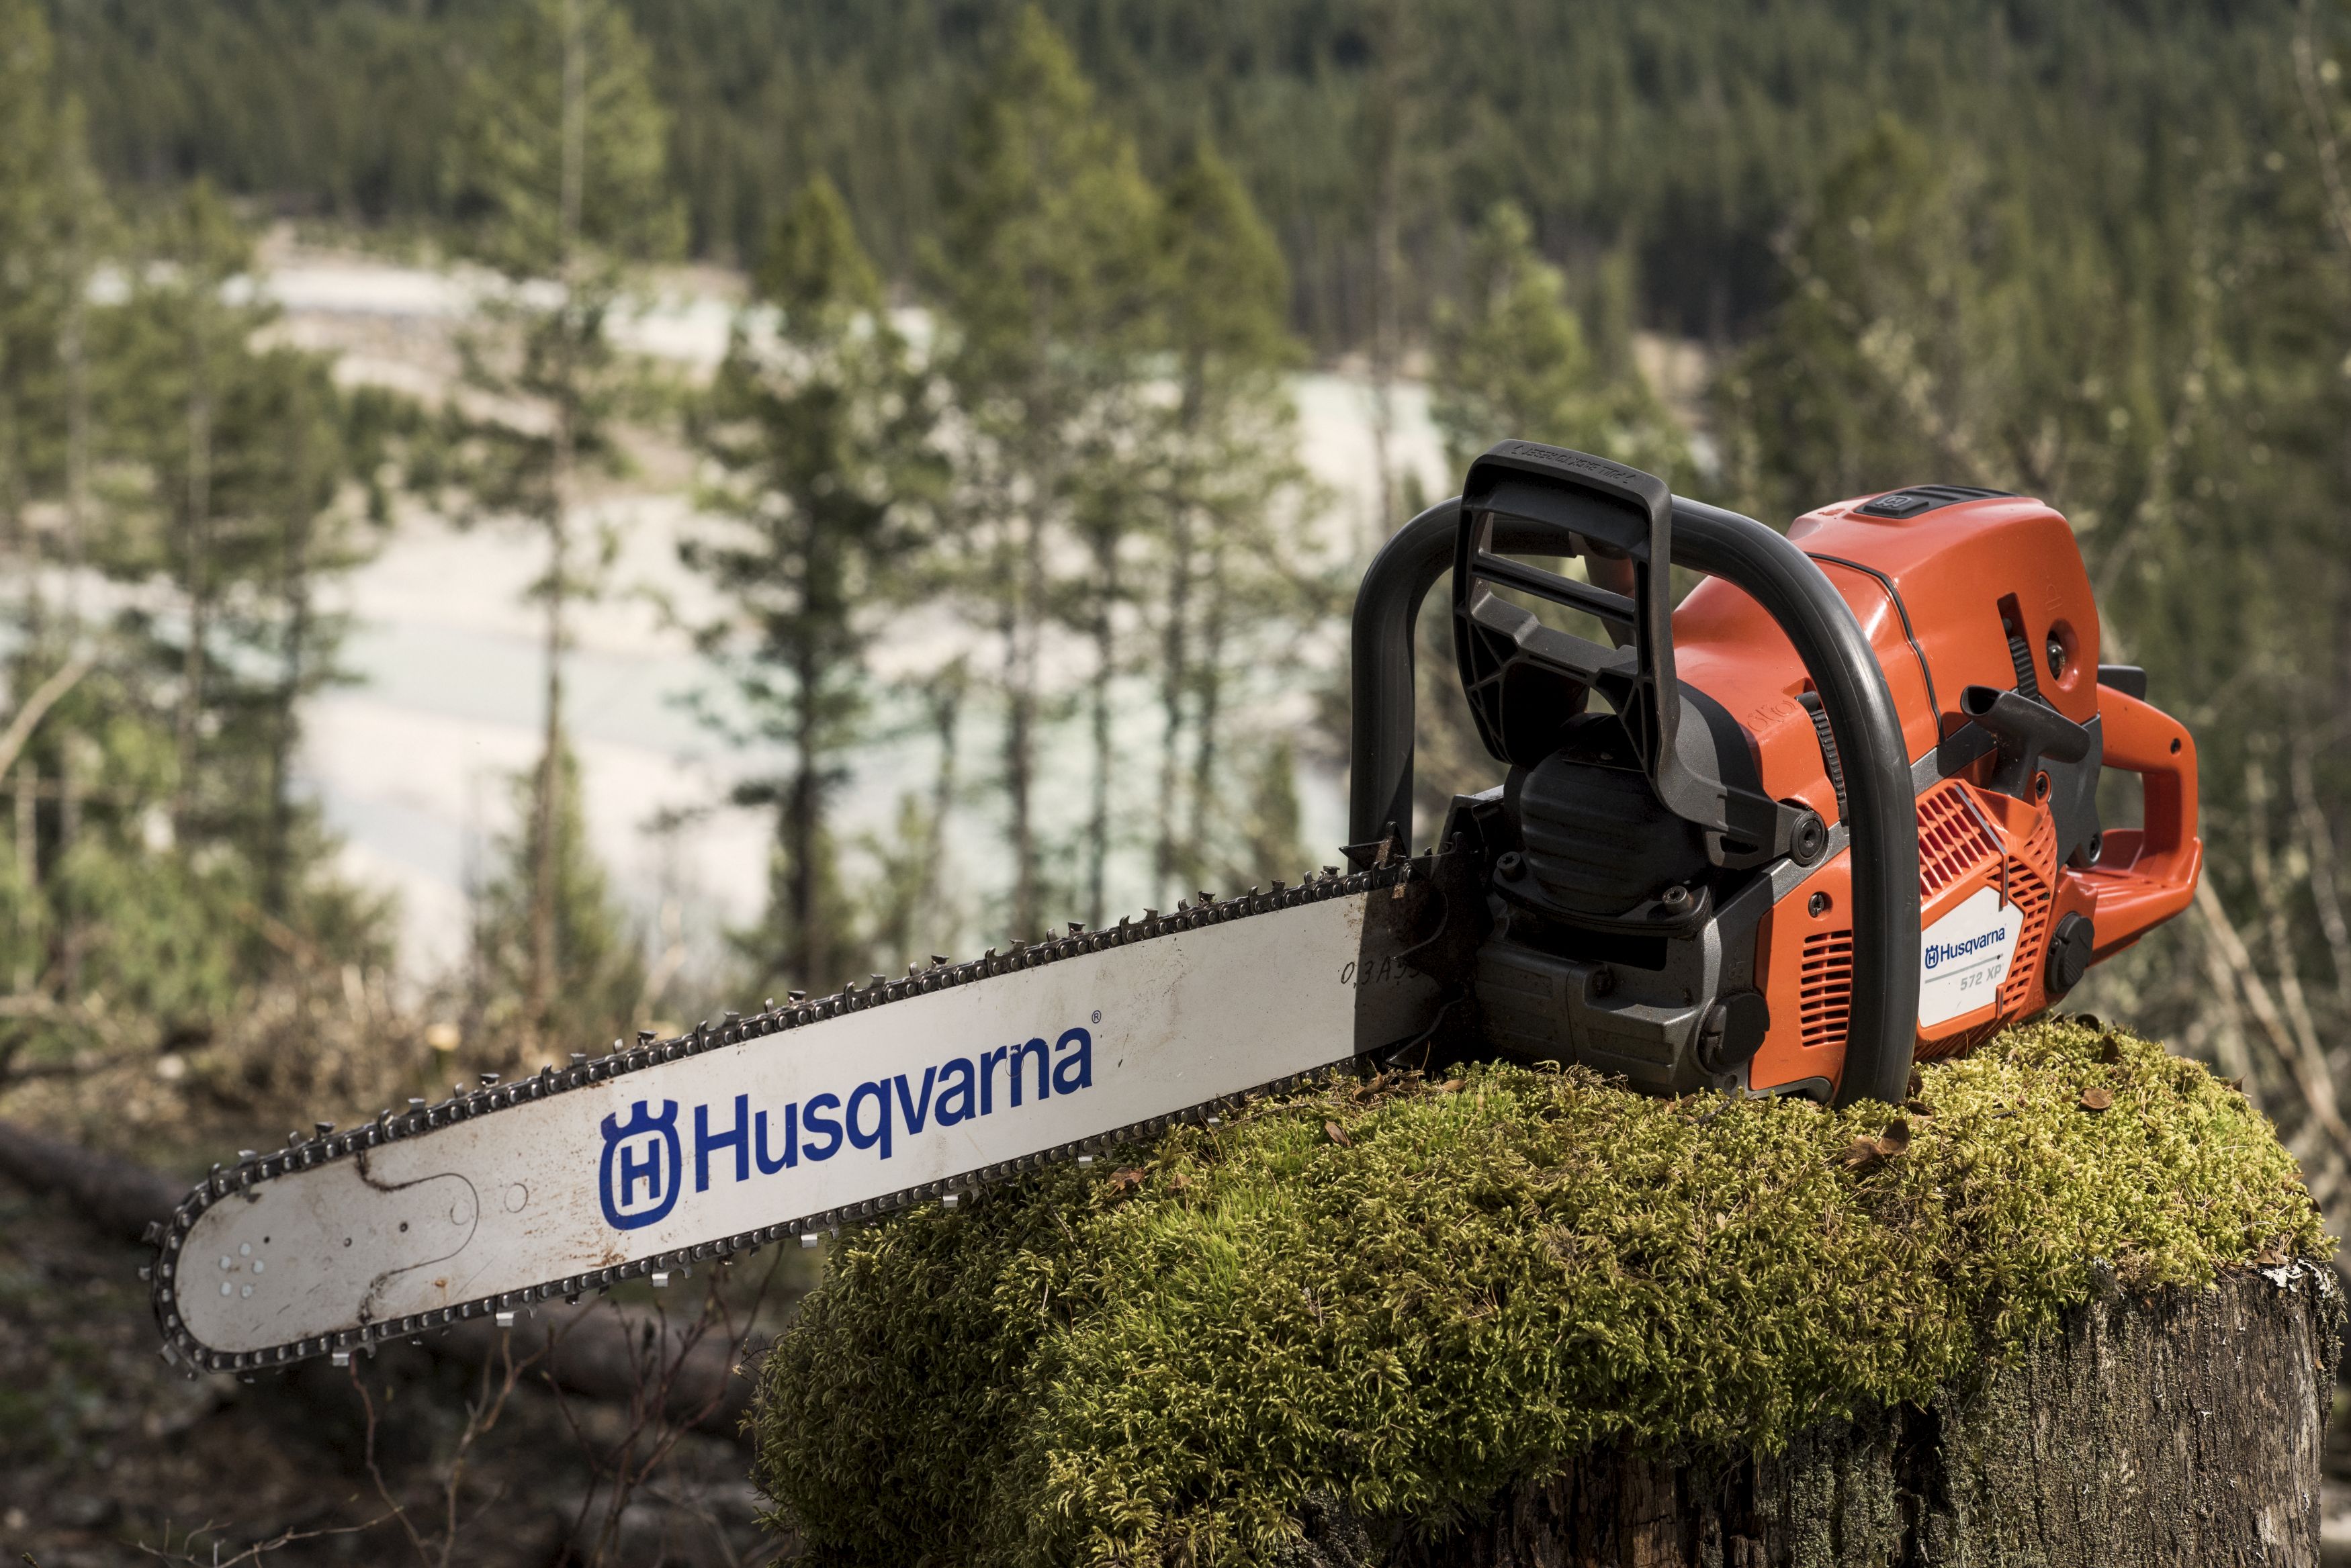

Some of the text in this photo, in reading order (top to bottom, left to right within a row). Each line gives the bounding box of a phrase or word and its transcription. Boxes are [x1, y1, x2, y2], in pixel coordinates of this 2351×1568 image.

[1597, 466, 1626, 479] PULL
[1941, 927, 2005, 962] Husqvarna
[1960, 964, 2002, 991] 572 XP
